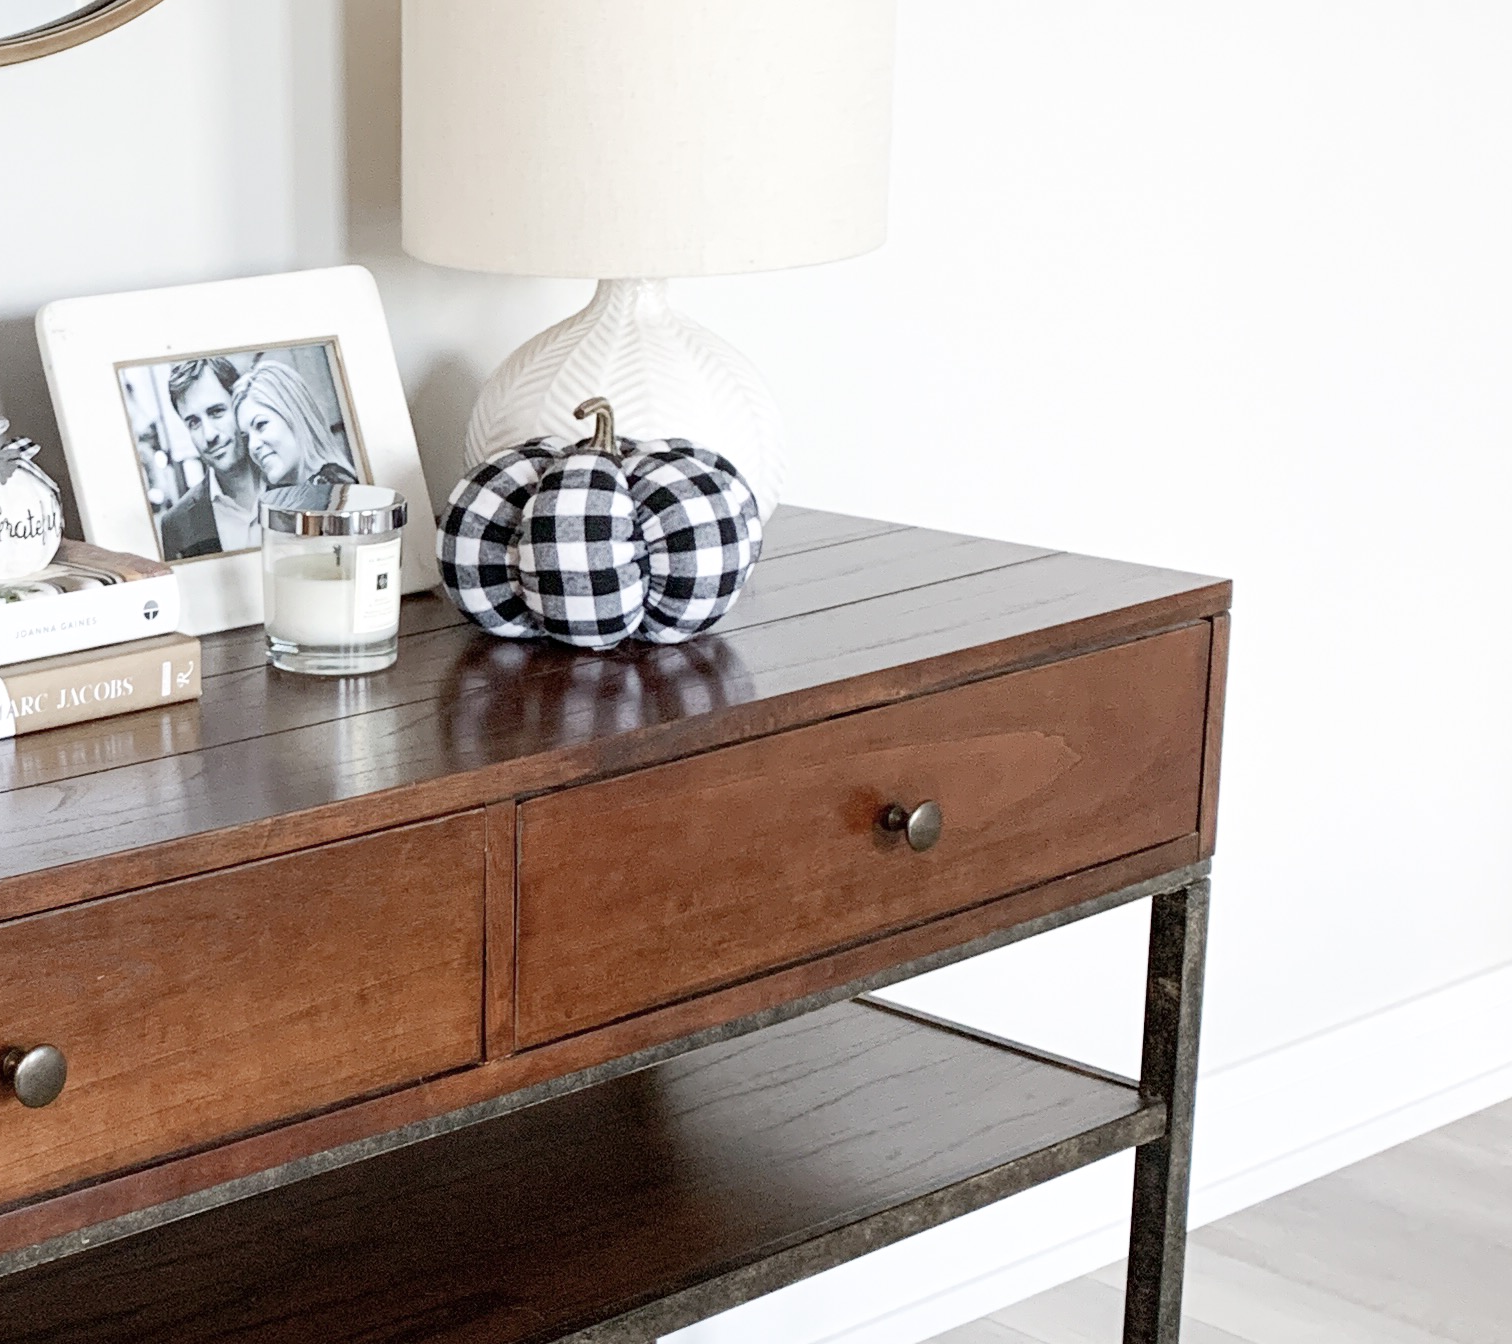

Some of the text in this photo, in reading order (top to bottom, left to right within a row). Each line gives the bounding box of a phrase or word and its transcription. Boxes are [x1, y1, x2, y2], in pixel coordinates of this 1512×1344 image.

[15, 616, 97, 639] JOANNA GAINES
[56, 676, 134, 709] JACOBS
